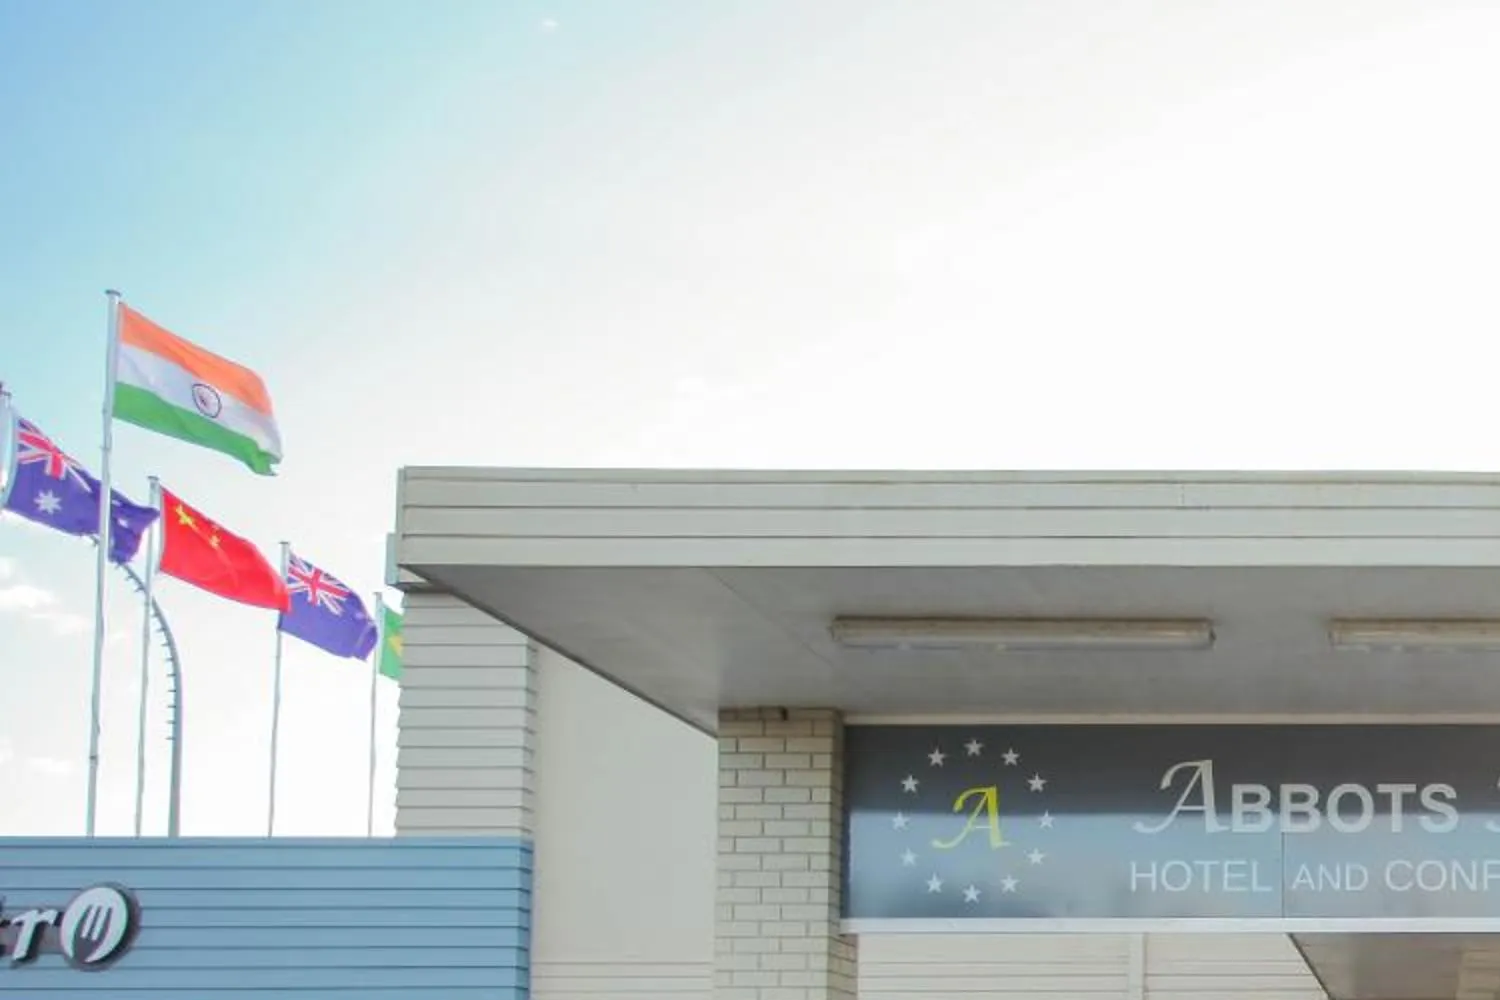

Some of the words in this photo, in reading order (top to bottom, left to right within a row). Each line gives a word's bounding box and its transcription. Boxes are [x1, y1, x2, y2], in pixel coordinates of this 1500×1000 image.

[932, 784, 1010, 849] A
[1130, 860, 1273, 892] HOTEL
[1292, 861, 1369, 892] AND
